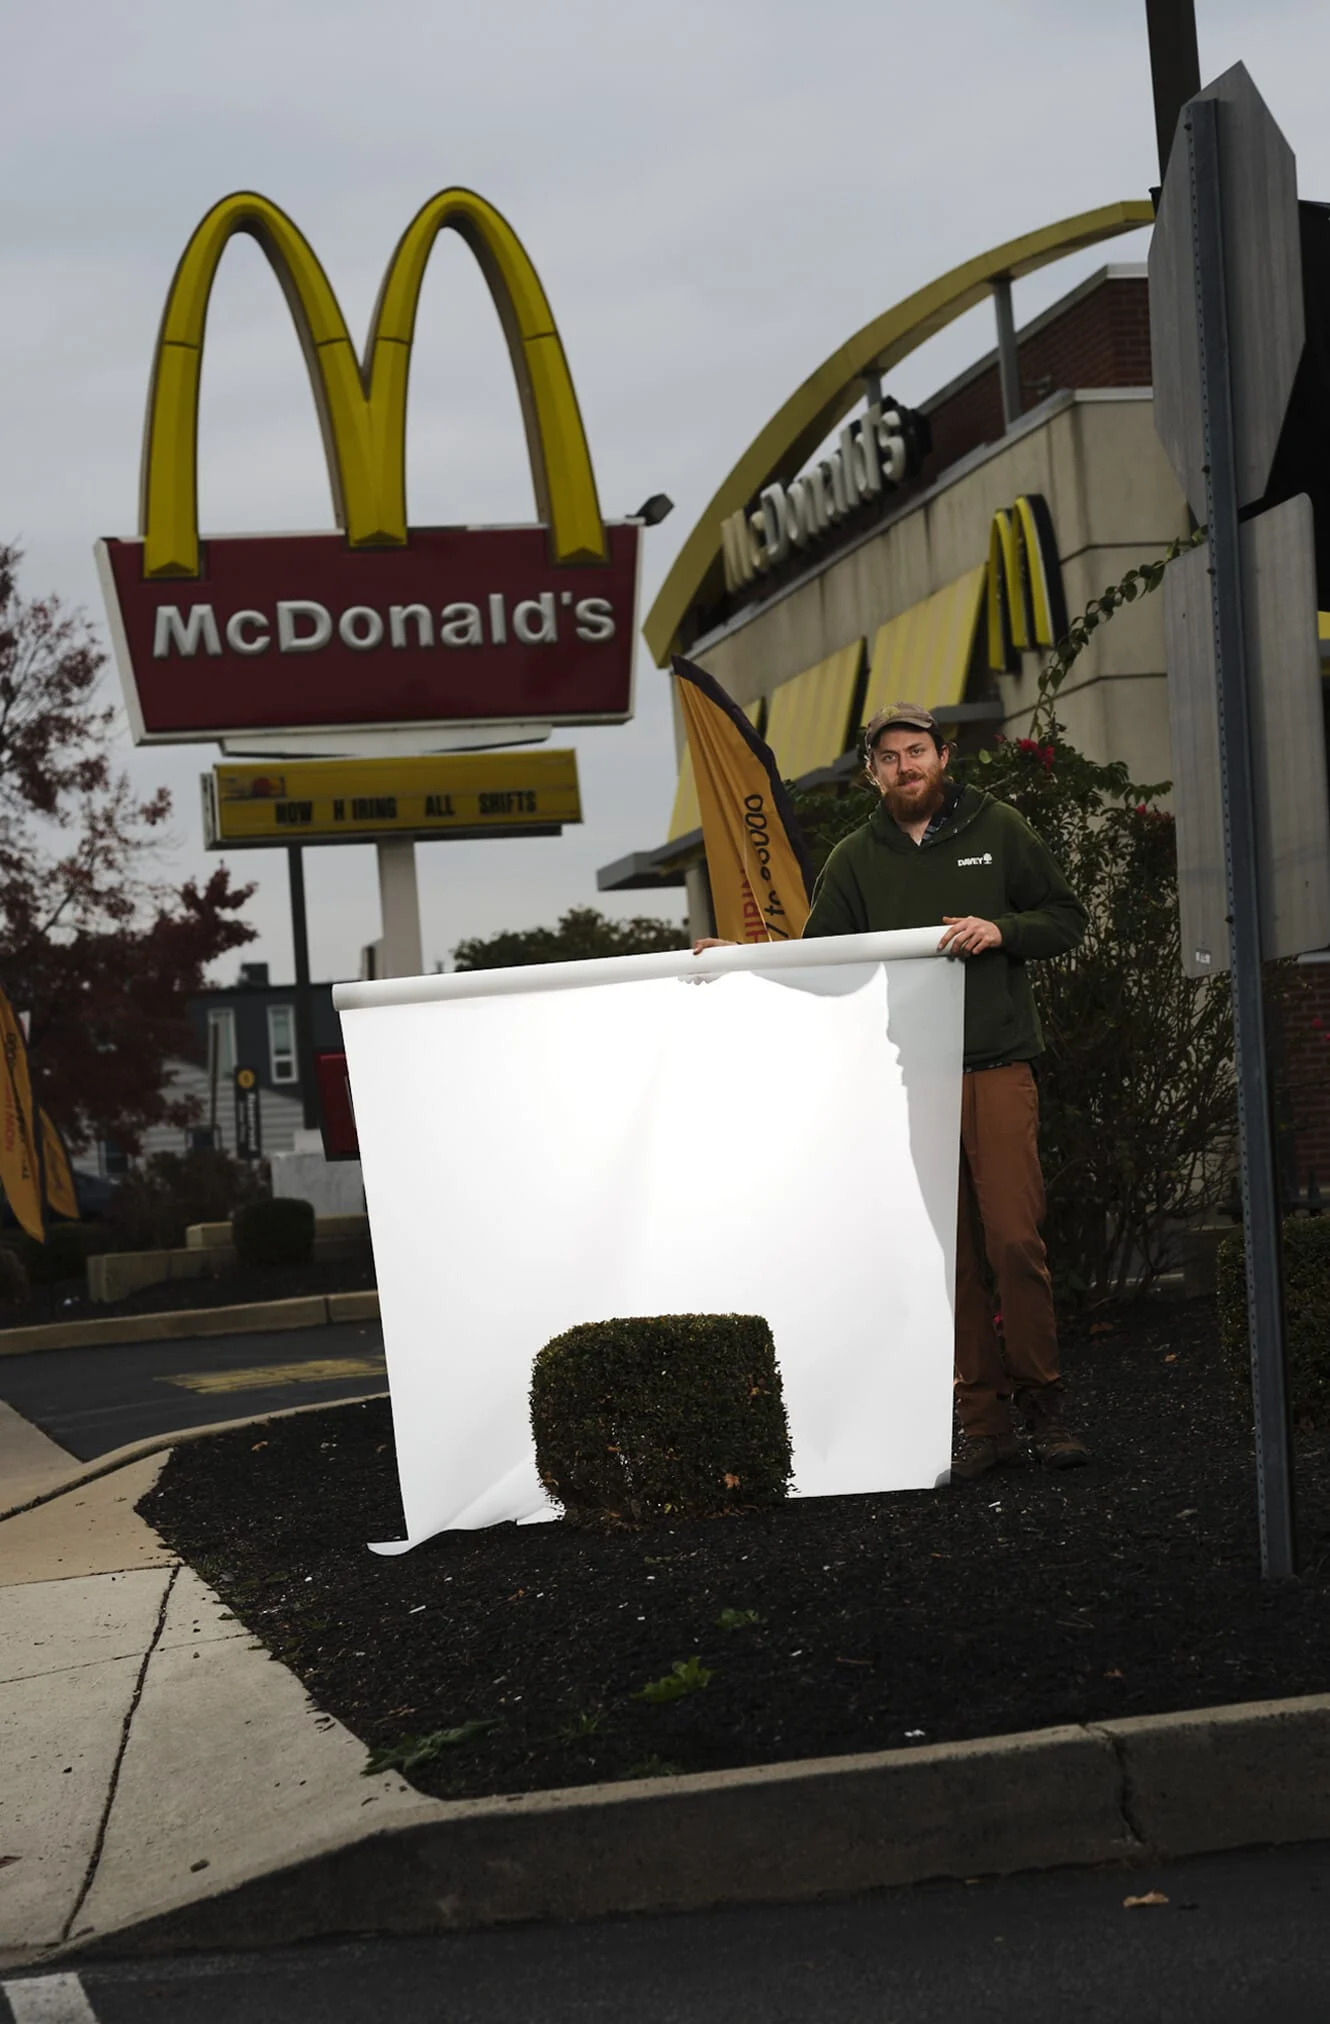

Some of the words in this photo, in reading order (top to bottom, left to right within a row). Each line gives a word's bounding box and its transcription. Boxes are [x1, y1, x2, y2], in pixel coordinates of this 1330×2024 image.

[721, 405, 906, 592] McDonald's
[153, 590, 616, 659] McDonald's
[276, 800, 313, 824] NOW
[425, 794, 455, 817] ALL
[478, 790, 538, 815] SHIFTS
[957, 857, 983, 867] DAVEY
